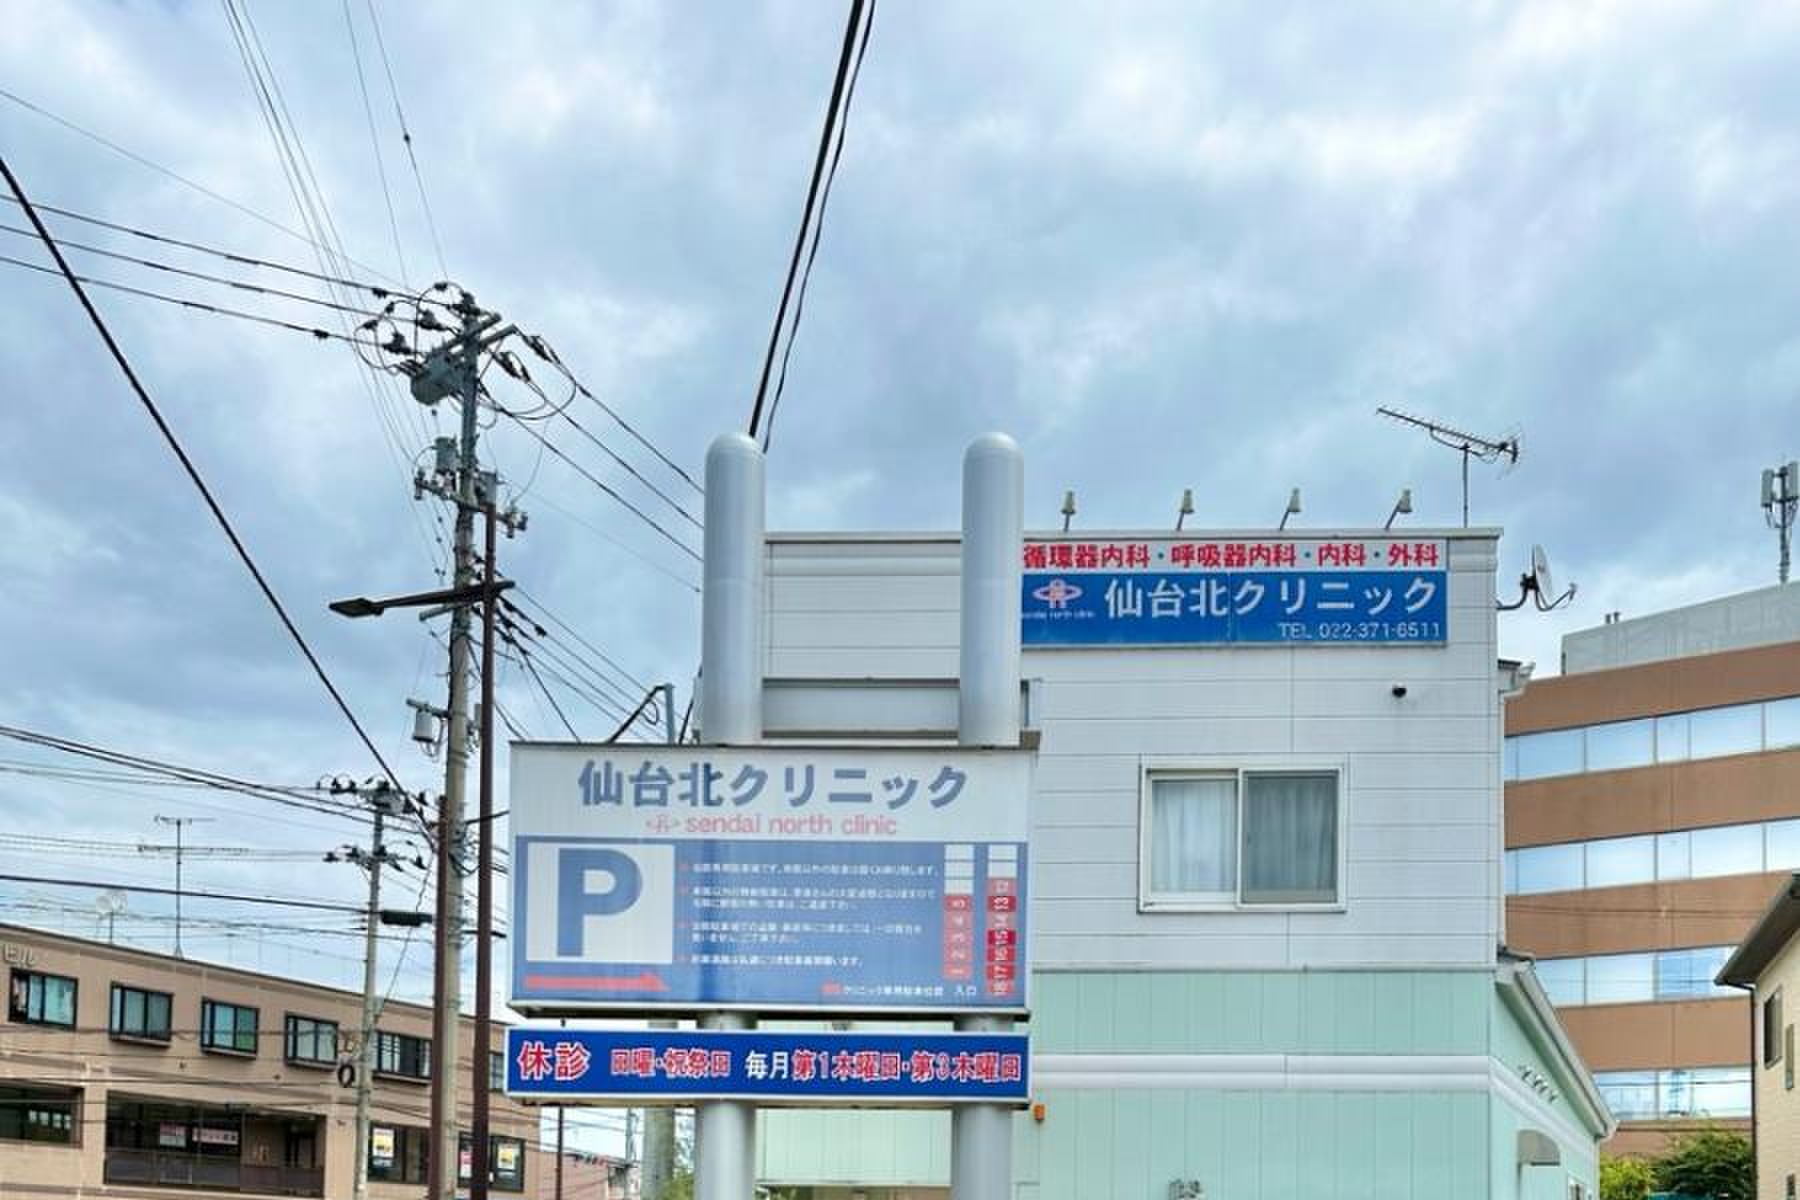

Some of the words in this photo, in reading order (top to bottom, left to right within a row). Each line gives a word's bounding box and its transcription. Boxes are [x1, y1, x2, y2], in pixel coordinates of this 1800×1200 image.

[1104, 577, 1436, 618] 仙台北クリニック
[1279, 622, 1312, 638] TEL
[577, 759, 967, 810] 仙台北クリニック
[768, 814, 832, 835] north
[841, 815, 897, 835] clinic
[556, 847, 644, 958] P
[516, 1040, 592, 1082] 休診
[610, 1046, 732, 1079] 日曜・祝祭日
